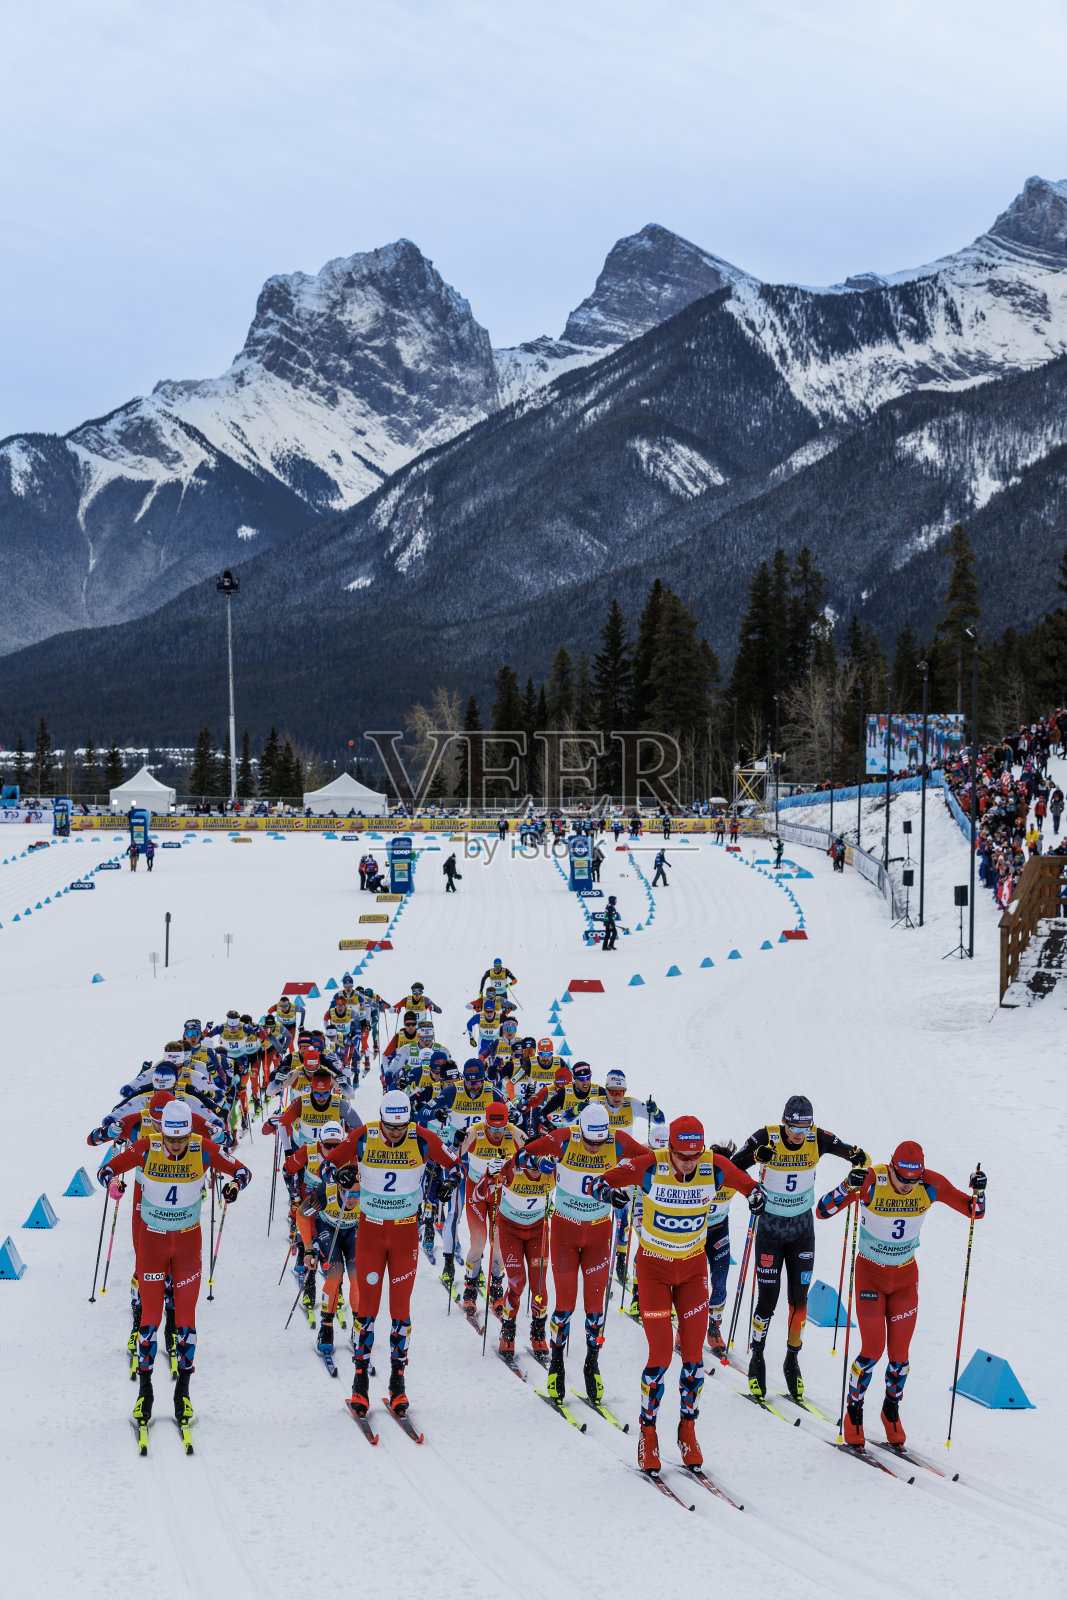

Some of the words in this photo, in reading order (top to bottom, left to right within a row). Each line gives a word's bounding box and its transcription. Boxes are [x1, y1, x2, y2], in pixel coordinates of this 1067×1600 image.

[367, 1152, 376, 1162] LE
[378, 1151, 410, 1162] GRUYÈRE
[568, 1152, 576, 1163] LE
[149, 1164, 158, 1173] LE
[159, 1164, 192, 1175] GRUYÈRE
[383, 1172, 396, 1192] 2
[582, 1176, 594, 1196] 6
[785, 1174, 798, 1193] 5
[165, 1186, 178, 1205] 4
[656, 1187, 666, 1199] LE
[668, 1186, 703, 1200] GRUYÈRE
[372, 1197, 406, 1206] CANMORE
[527, 1198, 538, 1211] 7
[568, 1199, 601, 1209] CANMORE
[773, 1197, 805, 1206] CANMORE
[876, 1199, 886, 1208] LE
[887, 1198, 920, 1209] GRUYÈRE
[154, 1209, 188, 1218] CANMORE
[655, 1212, 705, 1232] coop
[892, 1219, 906, 1240] 3
[878, 1244, 912, 1254] CANMORE
[642, 1249, 674, 1264] ELDORADO
[585, 1259, 609, 1274] CRAFT
[176, 1272, 201, 1288] CRAFT
[392, 1270, 414, 1284] CRAFT
[684, 1302, 706, 1321] CRAFT
[891, 1306, 919, 1322] CRAFT
